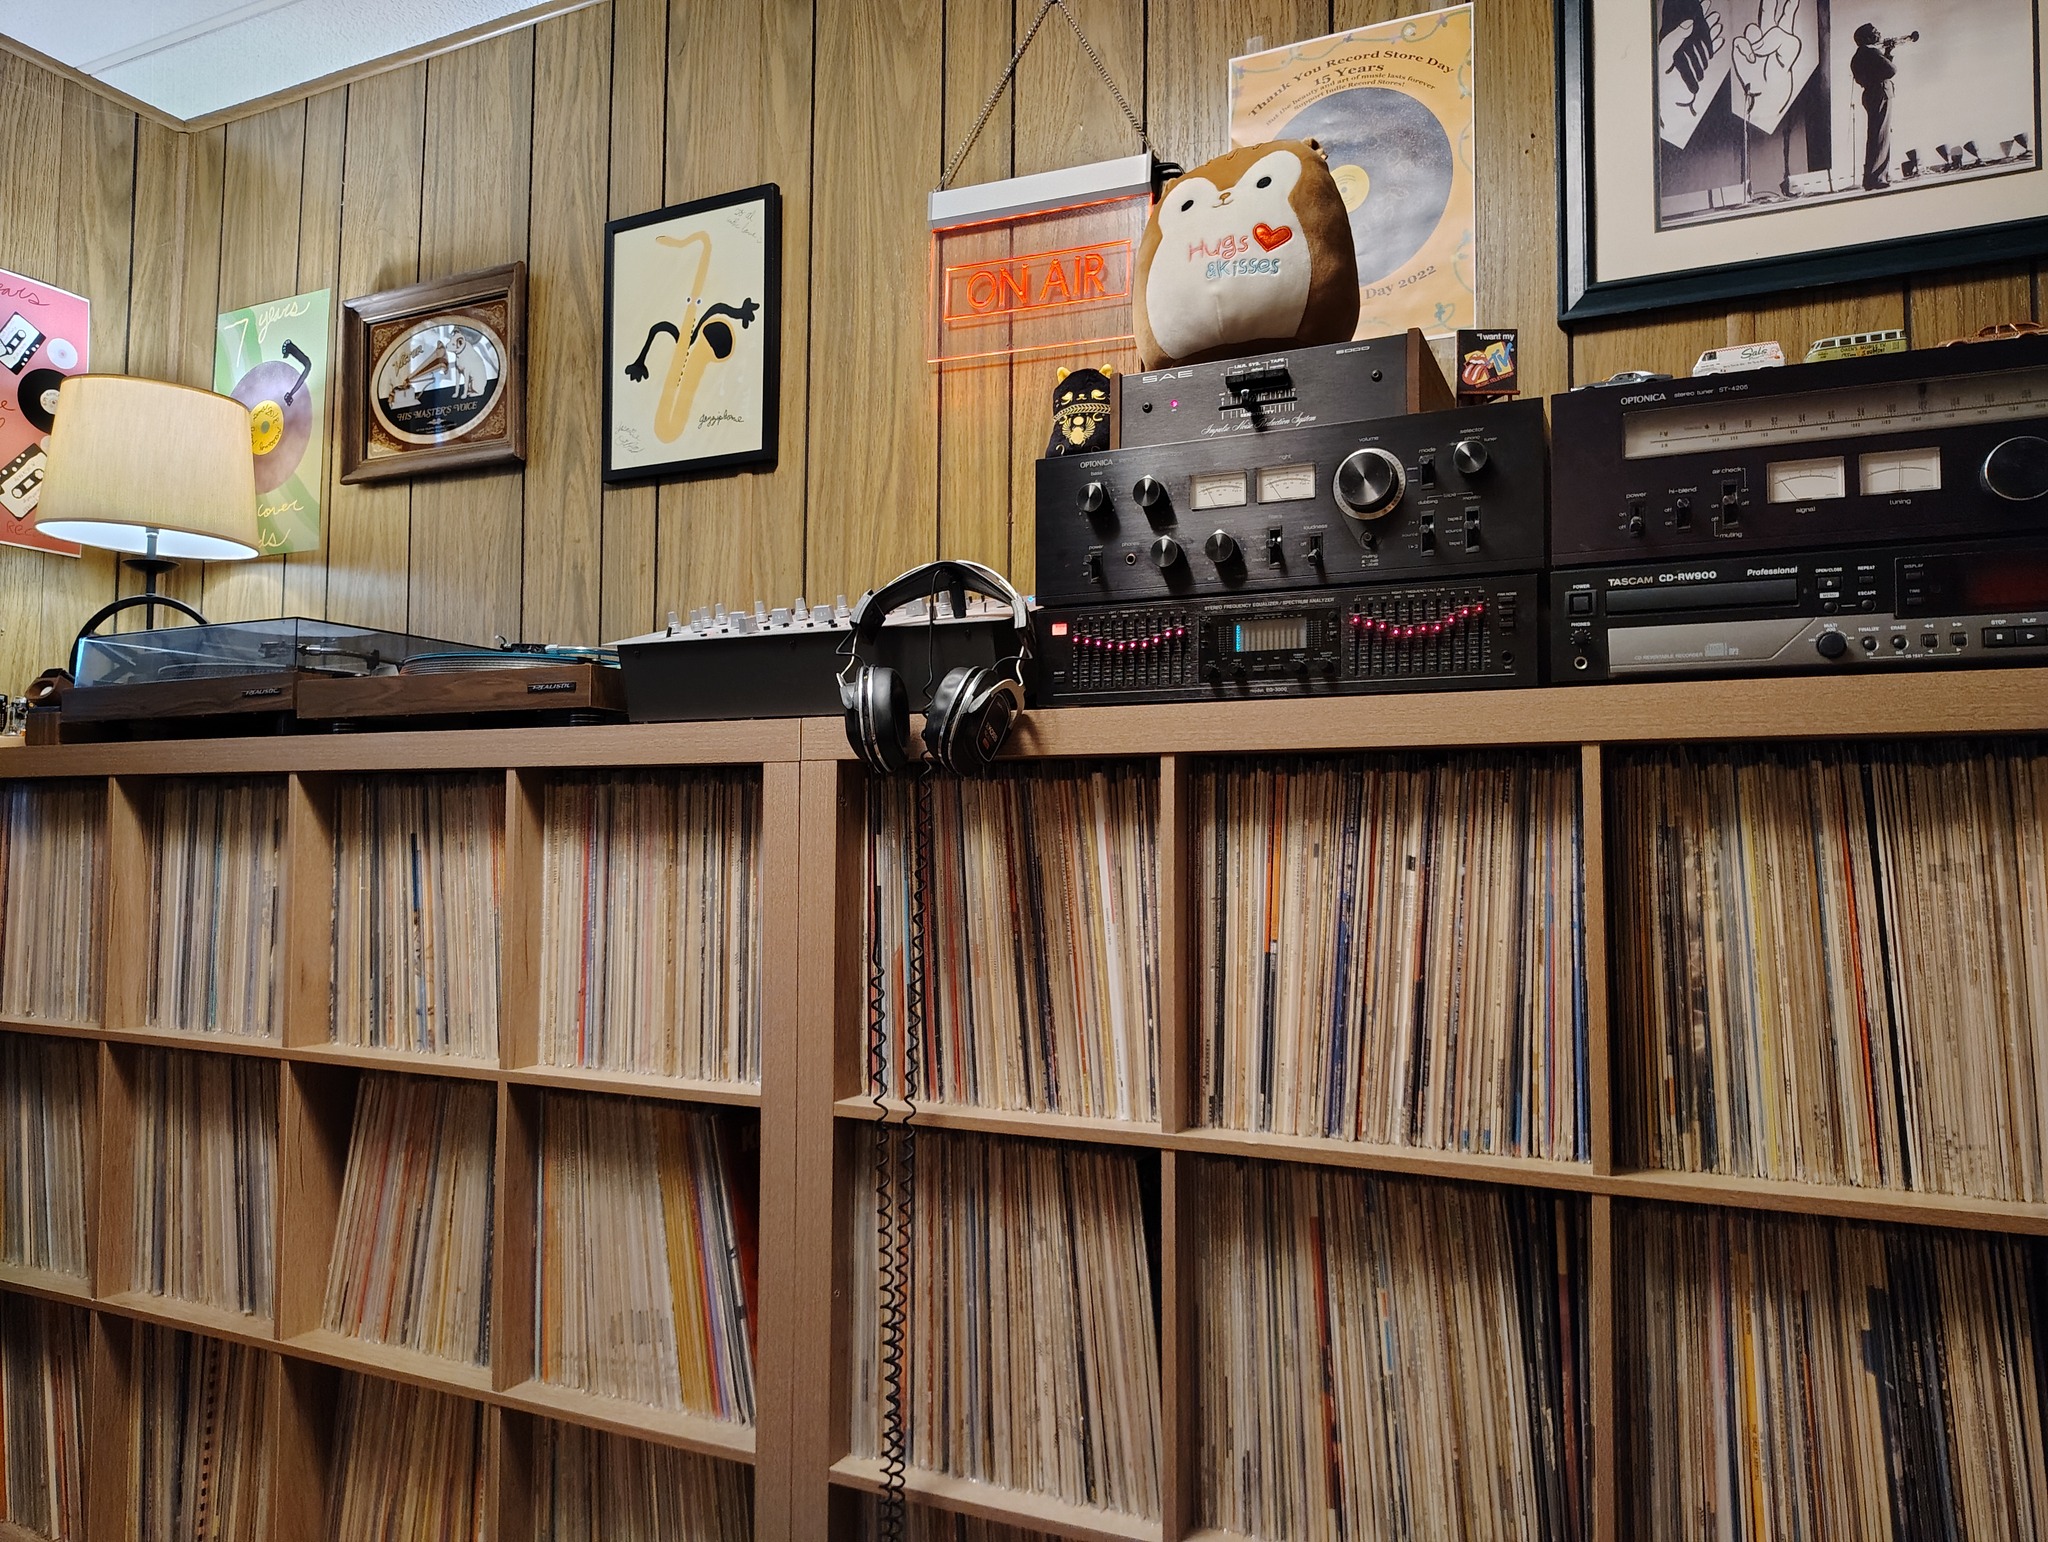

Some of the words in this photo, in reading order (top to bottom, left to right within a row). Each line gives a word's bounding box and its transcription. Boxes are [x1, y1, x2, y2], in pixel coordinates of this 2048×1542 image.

[1315, 74, 1331, 86] 15
[1335, 64, 1384, 77] Years
[1248, 82, 1291, 116] Thank
[1293, 66, 1321, 82] You
[1326, 50, 1379, 68] Record
[1383, 50, 1423, 62] Store
[1426, 57, 1454, 74] Day
[1292, 88, 1318, 105] beauty
[1320, 80, 1335, 91] and
[1337, 77, 1349, 85] art
[1407, 76, 1436, 90] forever
[1348, 79, 1376, 88] Record
[1377, 79, 1406, 88] Stores!
[1187, 234, 1249, 263] Hugs
[967, 264, 1029, 310] ON
[1038, 253, 1106, 301] AIR
[1365, 284, 1394, 300] Day
[1398, 265, 1437, 288] 2022
[224, 318, 249, 368] 7
[258, 301, 311, 344] years
[1483, 333, 1501, 341] want
[1502, 334, 1515, 342] my
[1142, 370, 1193, 384] SAE
[1621, 393, 1666, 405] OPTONICA
[397, 412, 412, 422] HIS
[413, 404, 452, 419] MASTER'S
[452, 401, 478, 412] VOICE
[1291, 412, 1316, 427] System
[1080, 459, 1113, 469] OPTONICA
[1669, 486, 1697, 494] hi-blend
[1890, 498, 1911, 506] tuning
[1796, 506, 1816, 514] signal
[1608, 576, 1653, 587] TASCAM
[1659, 571, 1717, 582] CD-RW900
[1747, 566, 1798, 577] Professional
